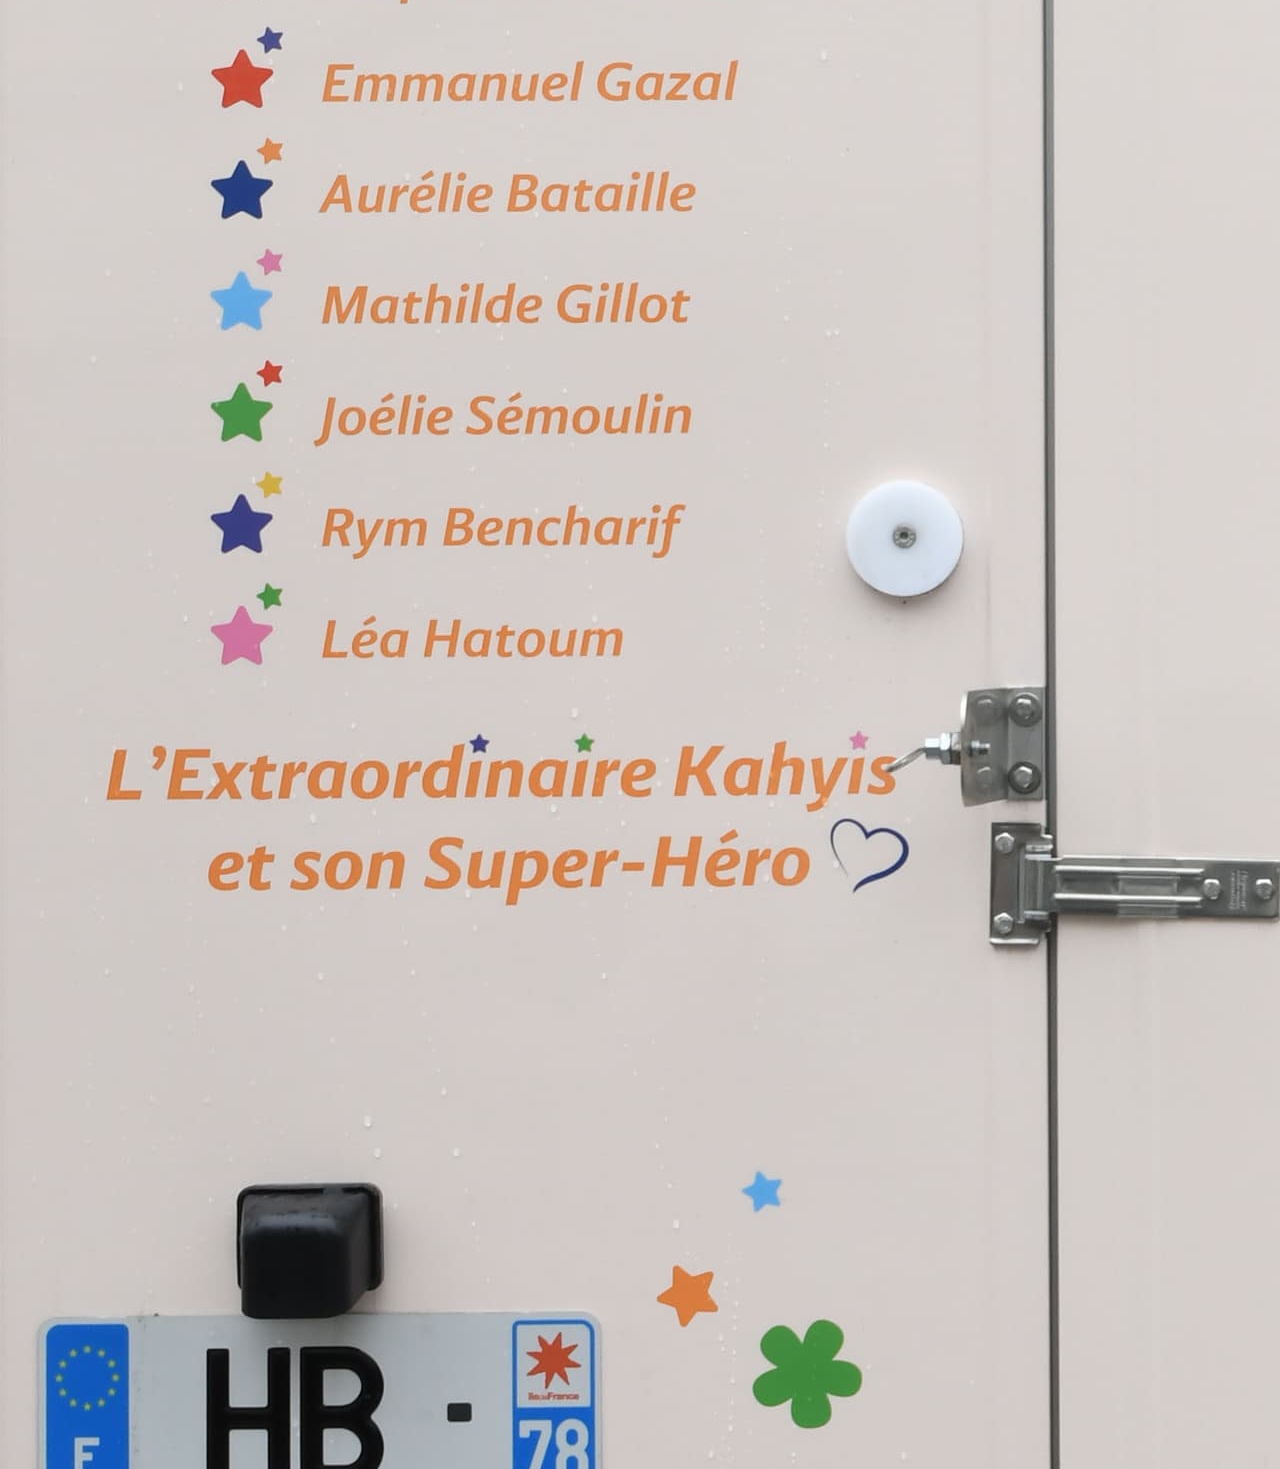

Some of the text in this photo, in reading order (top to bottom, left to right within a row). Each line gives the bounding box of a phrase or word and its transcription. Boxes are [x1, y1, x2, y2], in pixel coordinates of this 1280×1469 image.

[322, 60, 740, 104] Emmanuel Gazal
[320, 171, 698, 215] Aurélie Bataille
[322, 282, 692, 326] Mathilde Gillot
[314, 392, 694, 449] Joélie Sémoulin
[322, 503, 685, 561] Rym Bencharif
[322, 616, 625, 661] Léa Hatoum
[674, 740, 898, 814] Kahyis
[208, 829, 812, 908] et son Super-Héro
